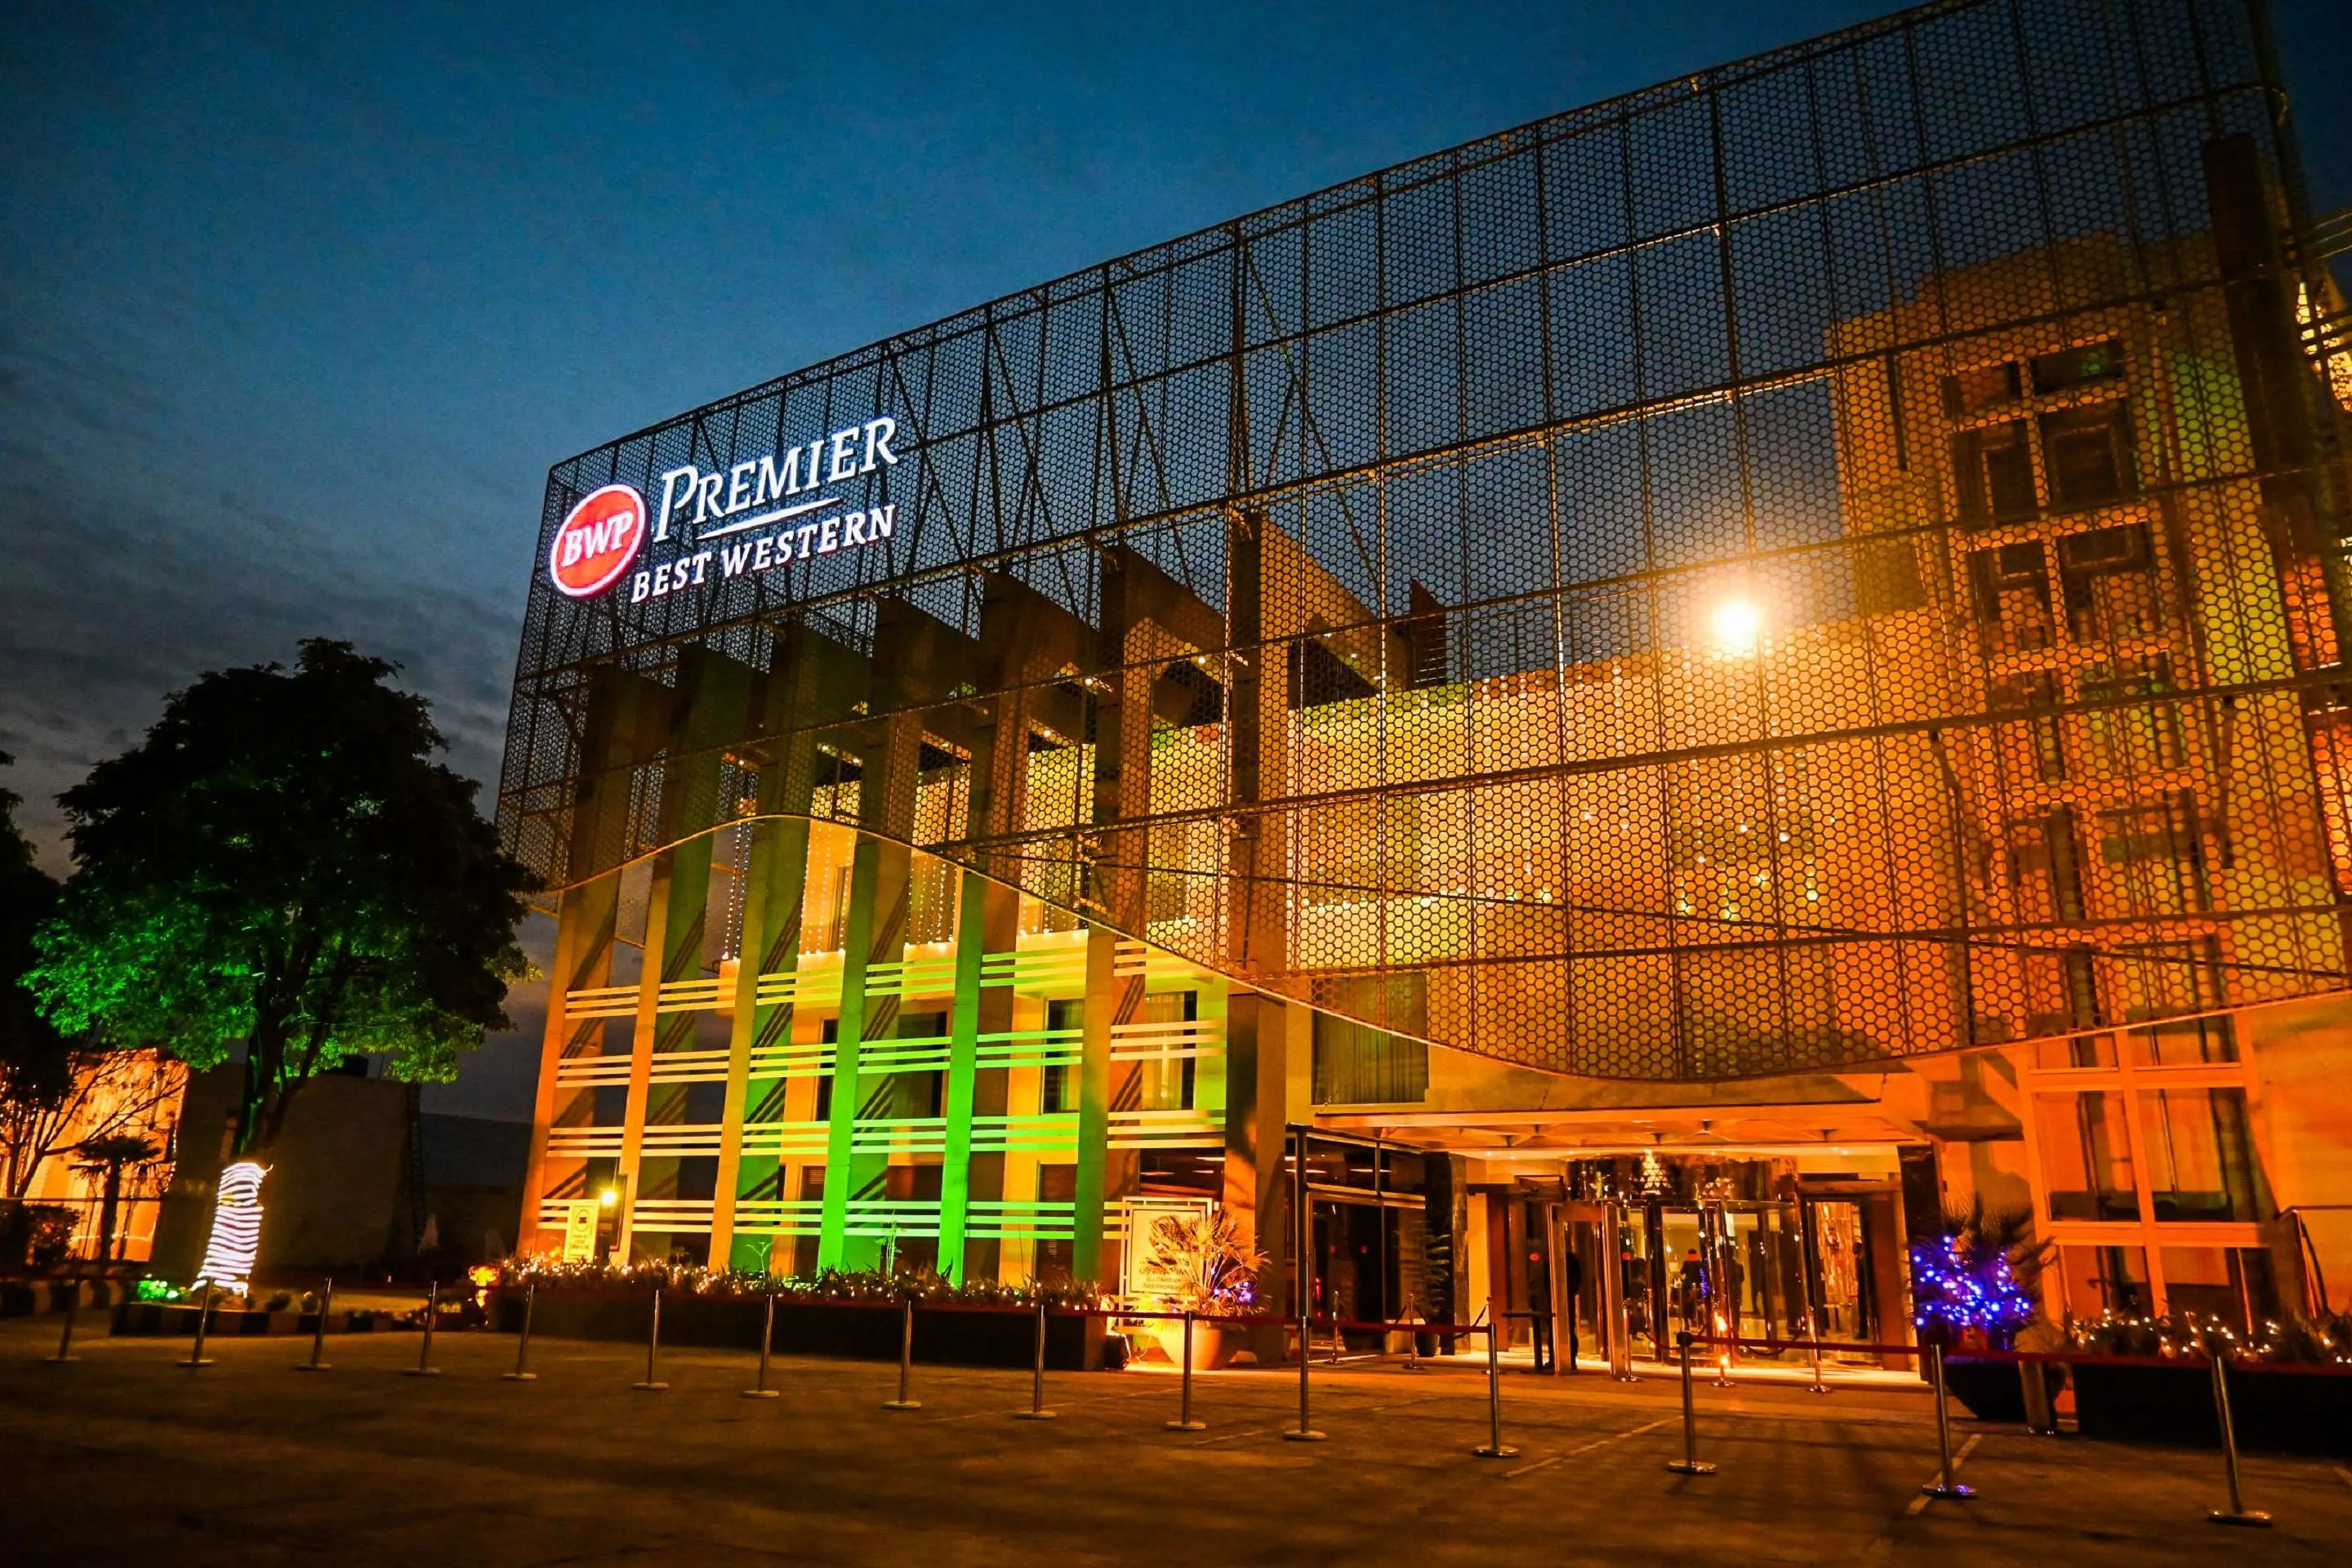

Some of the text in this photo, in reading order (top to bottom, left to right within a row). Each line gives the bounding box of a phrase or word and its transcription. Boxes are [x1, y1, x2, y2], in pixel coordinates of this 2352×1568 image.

[654, 417, 898, 543] PREMIER
[561, 510, 634, 568] BWP
[630, 505, 896, 603] BEST WESTERN
